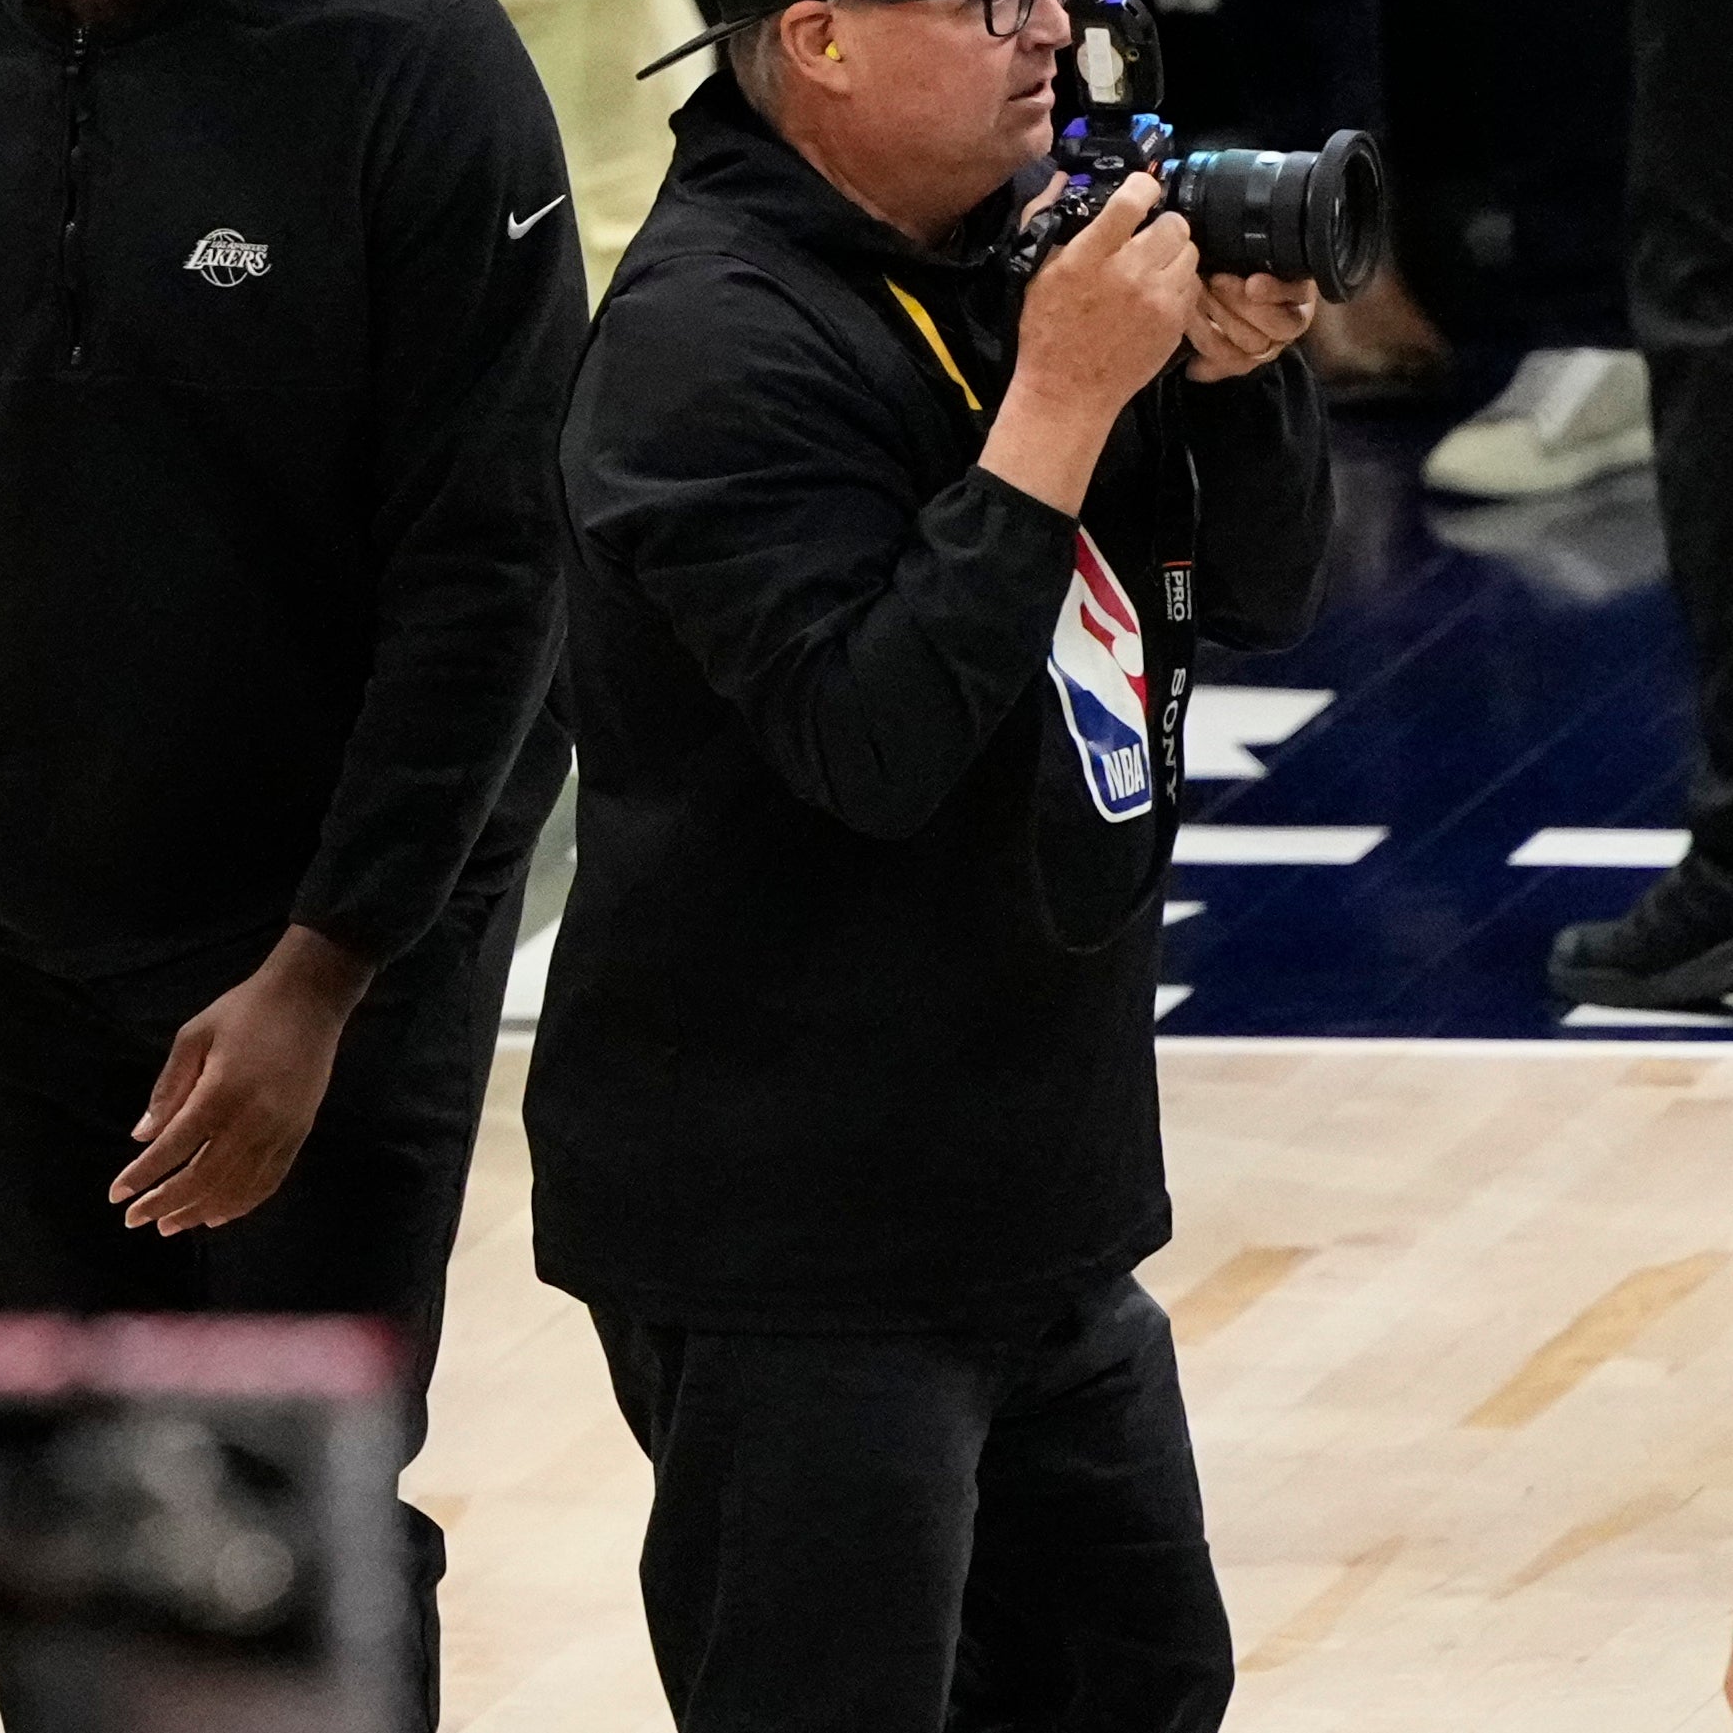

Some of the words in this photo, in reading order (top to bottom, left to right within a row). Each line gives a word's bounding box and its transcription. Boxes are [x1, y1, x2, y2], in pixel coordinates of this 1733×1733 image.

[183, 240, 272, 276] LAKERS
[1171, 570, 1186, 622] PRO
[1162, 668, 1186, 804] SONY
[1101, 743, 1146, 802] NBA
